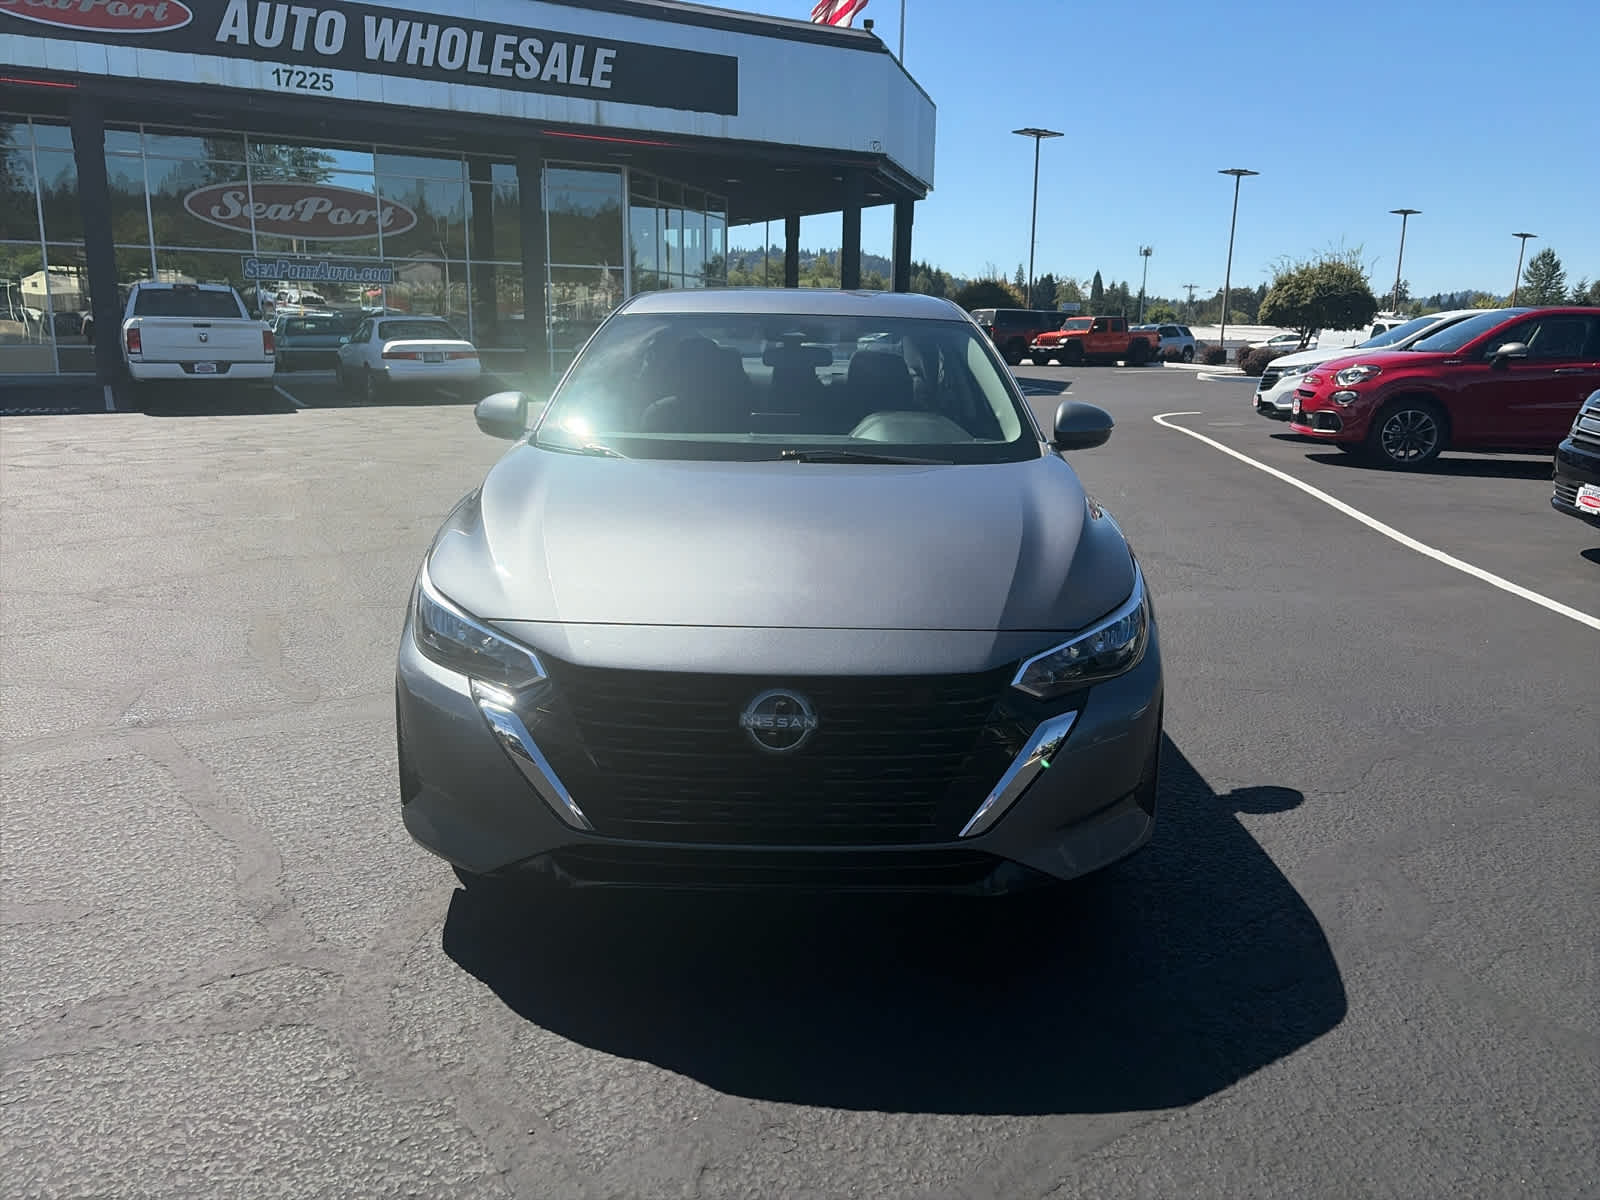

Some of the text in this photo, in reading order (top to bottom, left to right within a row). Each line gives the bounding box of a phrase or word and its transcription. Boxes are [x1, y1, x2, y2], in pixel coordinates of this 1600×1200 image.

[215, 0, 617, 89] AUTO WHOLESALE
[271, 68, 334, 92] 17225
[210, 191, 394, 227] SeaPort
[740, 714, 817, 728] NISSAN
